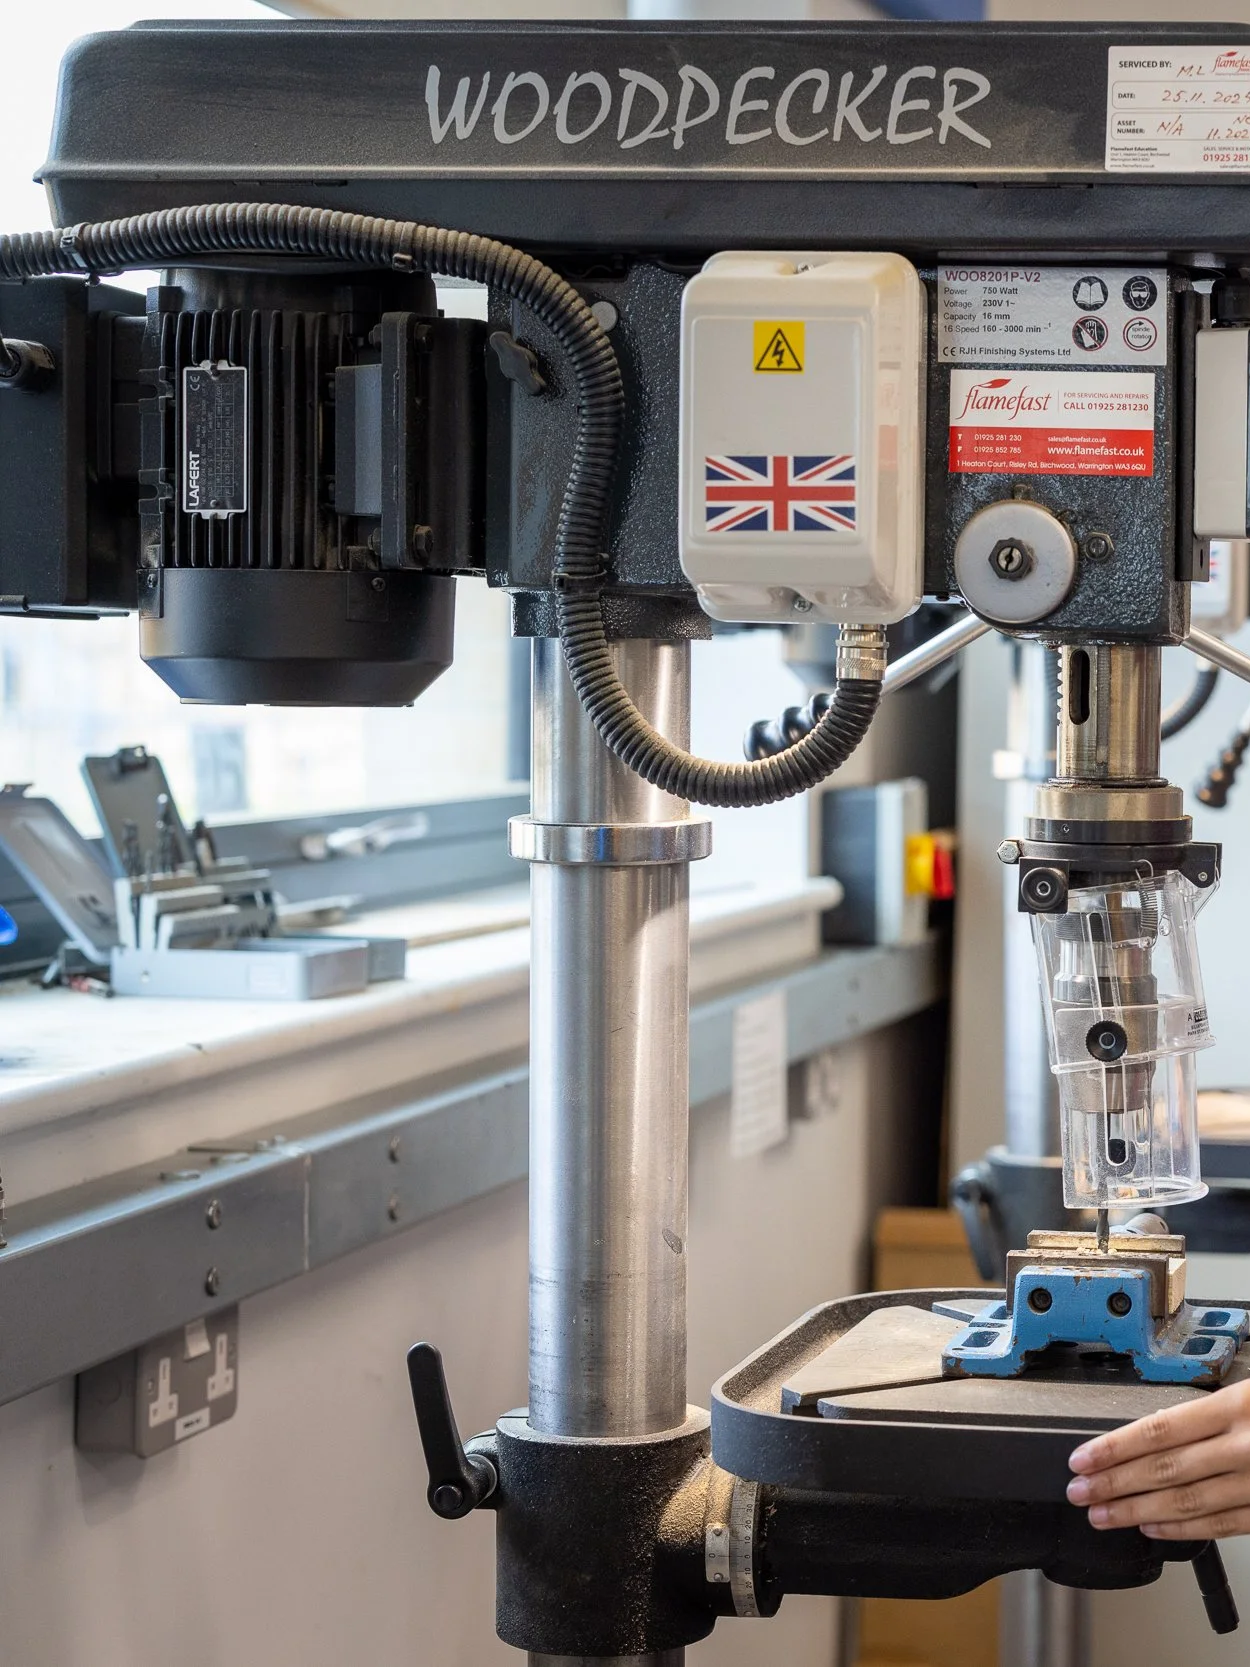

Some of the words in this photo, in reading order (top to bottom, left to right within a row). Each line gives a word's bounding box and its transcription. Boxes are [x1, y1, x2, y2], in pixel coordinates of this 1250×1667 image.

[1118, 60, 1158, 68] SERVICED
[1160, 60, 1172, 68] BY:
[425, 64, 991, 149] WOODPECKER
[1157, 115, 1184, 136] N/A
[1203, 154, 1230, 162] 01925
[1233, 154, 1249, 162] 281
[944, 287, 968, 295] Power
[944, 300, 972, 309] Voltage
[944, 312, 976, 322] Capacity
[955, 325, 979, 334] Speed
[959, 347, 976, 355] RJH
[979, 347, 1016, 356] Finishing
[1019, 348, 1055, 357] Systems
[955, 384, 1052, 420] flamefast
[1064, 402, 1085, 410] CALL
[1088, 402, 1114, 410] 01925
[1117, 403, 1149, 411] 281230
[1048, 445, 1144, 456] www.flamefast.co.uk
[189, 451, 200, 507] LAFERT
[747, 1504, 753, 1513] 30
[745, 1520, 752, 1529] 20
[745, 1536, 750, 1544] 10
[746, 1581, 752, 1589] 20
